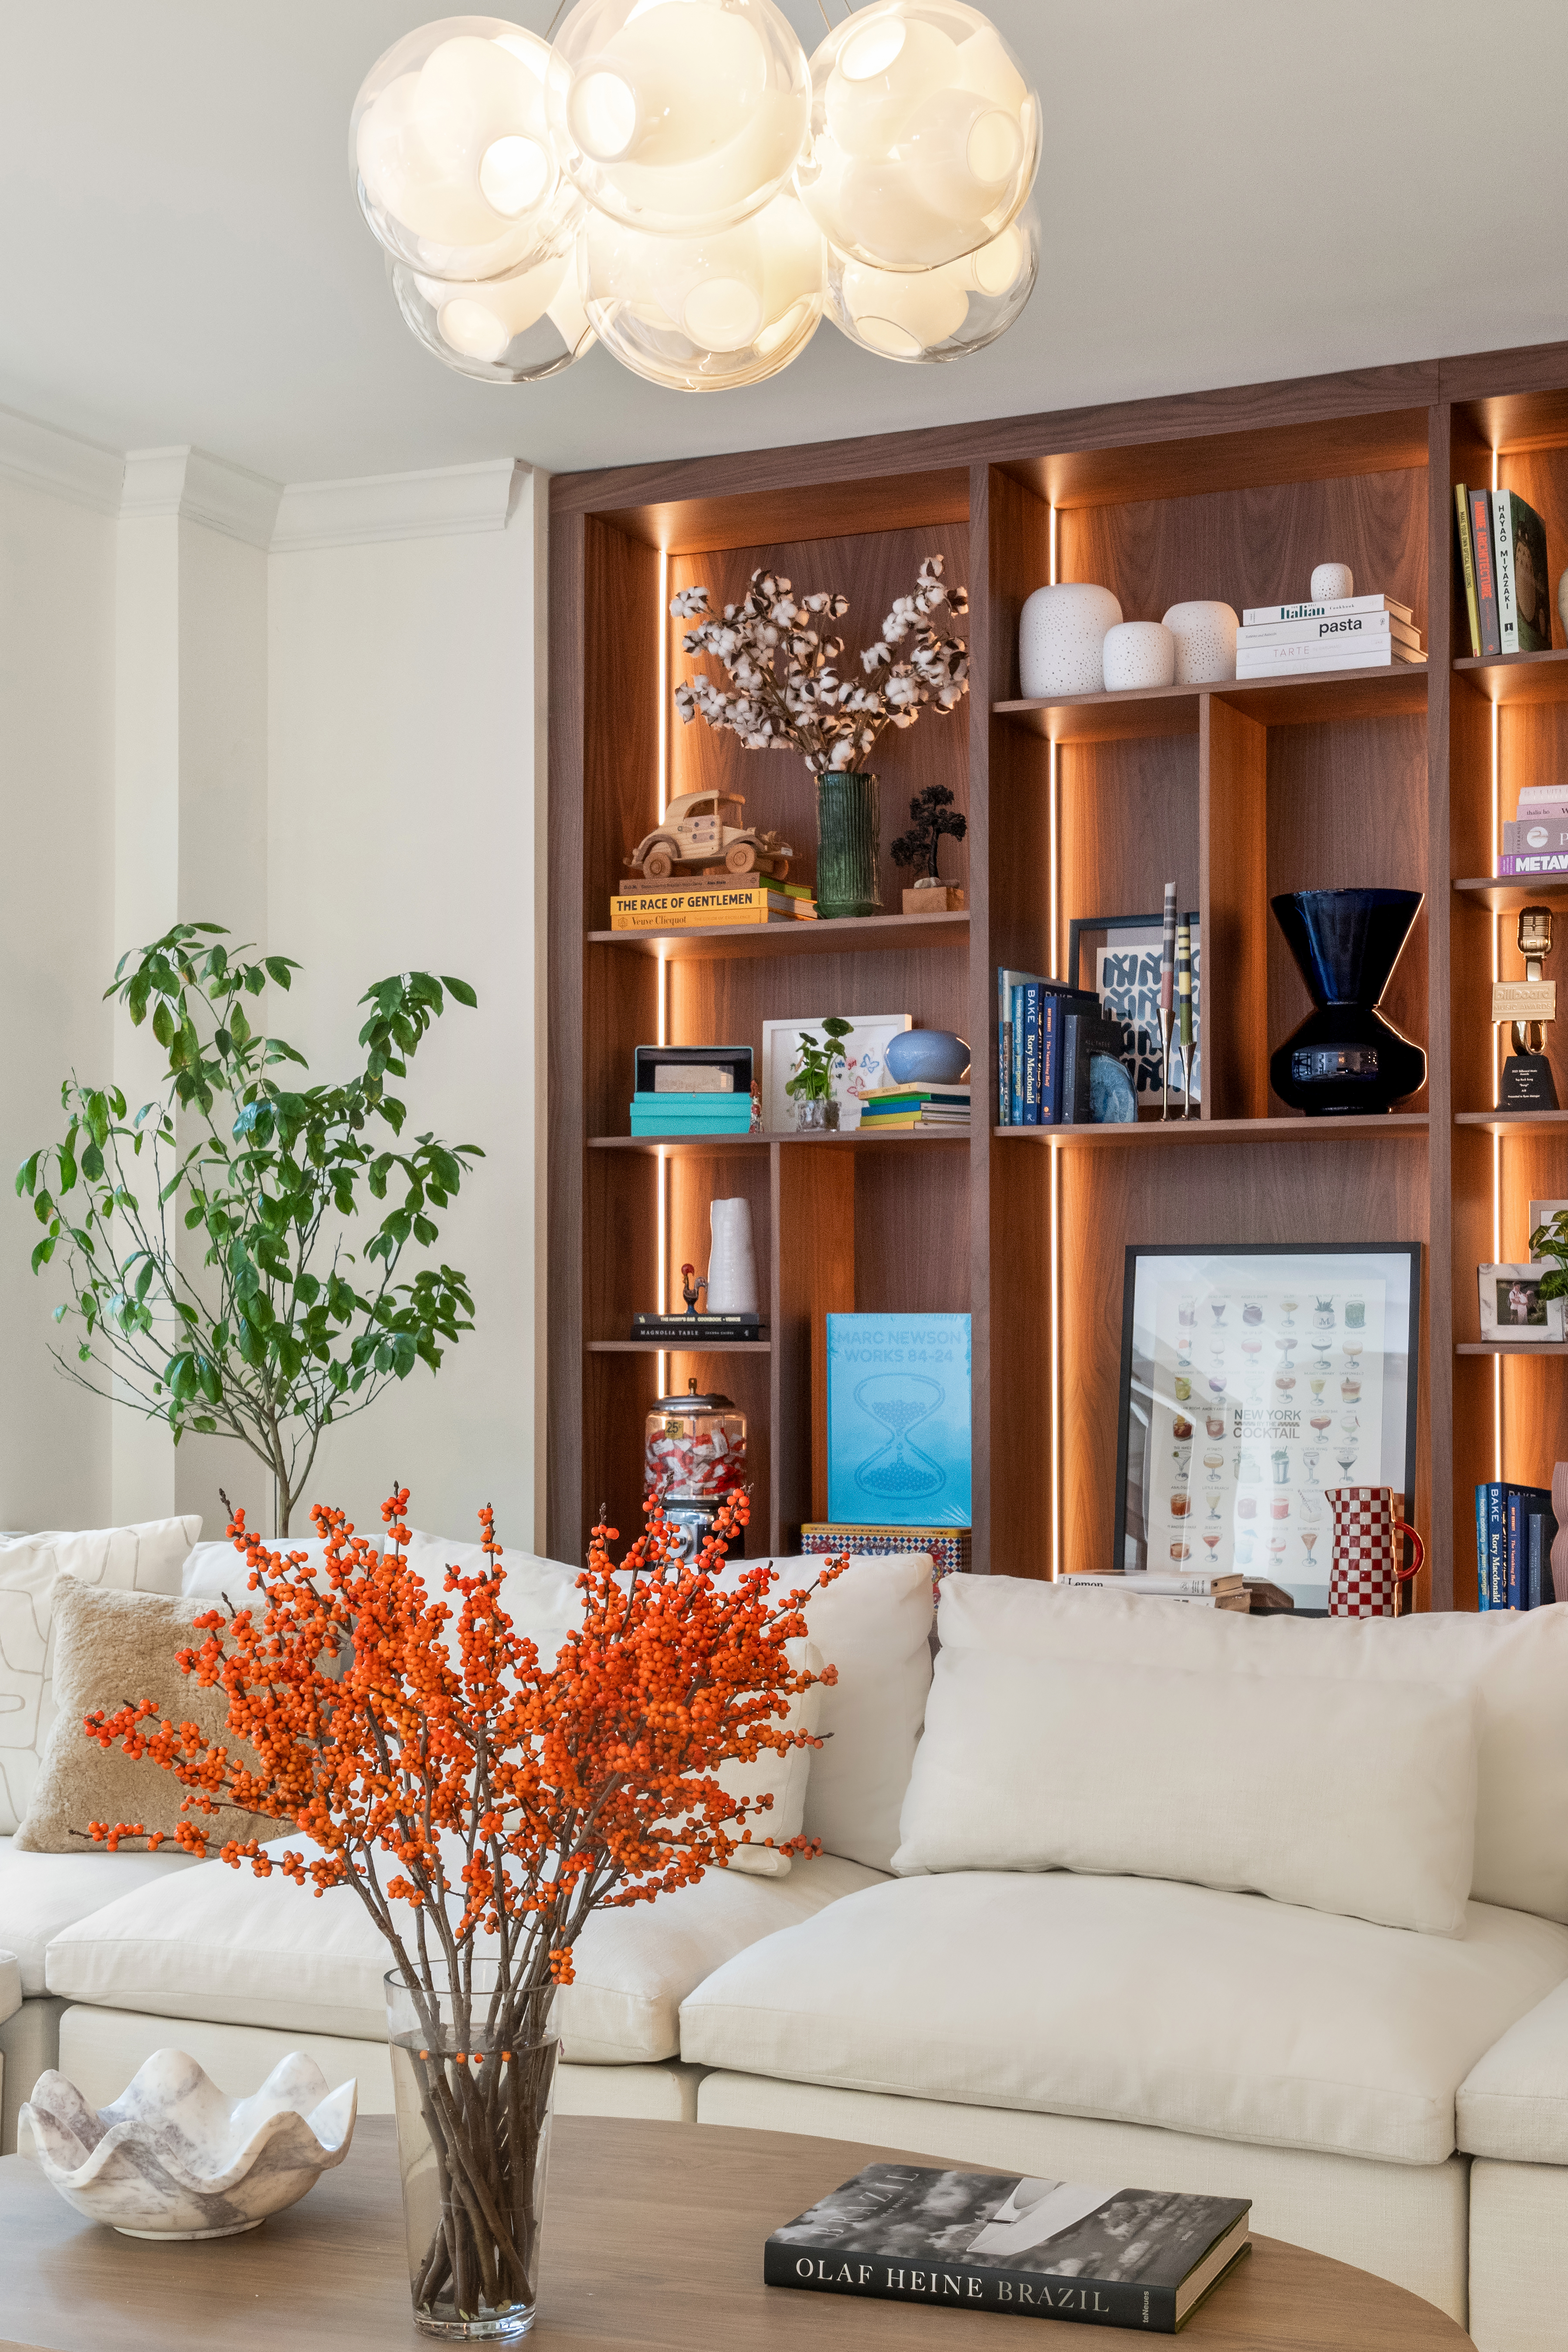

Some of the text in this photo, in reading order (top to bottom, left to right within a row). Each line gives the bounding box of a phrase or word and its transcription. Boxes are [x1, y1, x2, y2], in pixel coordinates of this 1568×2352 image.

[1474, 501, 1492, 600] ANIME ARCHITECTURE
[1498, 505, 1510, 610] HAYAO MIYAZAKI
[1281, 605, 1325, 620] Italian
[1319, 618, 1362, 637] pasta
[1273, 645, 1309, 658] TARTE
[617, 899, 637, 911] THE
[640, 898, 667, 911] RACE
[671, 896, 684, 908] OF
[687, 893, 753, 907] GENTLEMEN
[632, 916, 654, 926] Veuve
[655, 915, 687, 926] Clicquot
[1494, 988, 1551, 1000] billboard
[1025, 990, 1035, 1104] BAKE Rory Macdonald
[838, 1331, 961, 1344] MARC NEWSON
[844, 1349, 954, 1363] WORKS 84-24
[1234, 1409, 1302, 1421] NEW YORK
[1233, 1427, 1300, 1439] COCKTAIL
[1490, 1489, 1500, 1603] BAKE Rory Macdonald
[1068, 1577, 1103, 1587] Lemon
[809, 2173, 919, 2237] BRAZIL
[880, 2196, 909, 2218] OLAF HEINE
[795, 2257, 1110, 2313] OLAF HEINE BRAZIL
